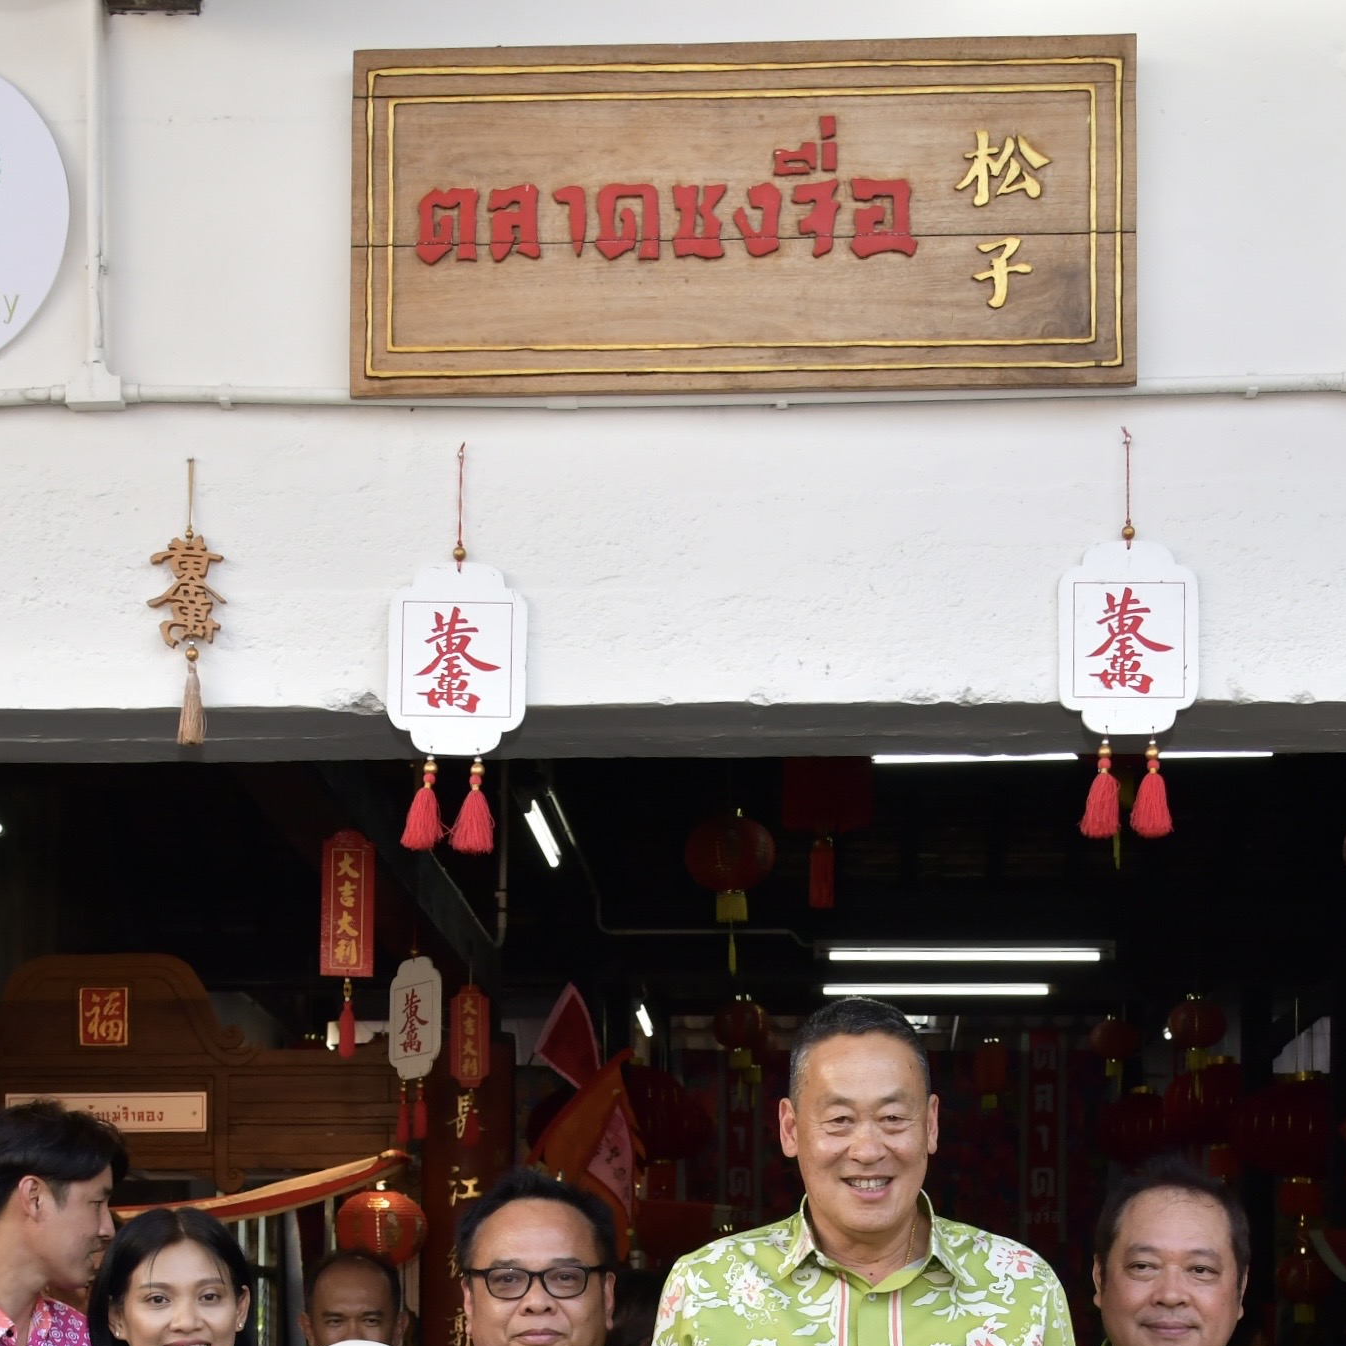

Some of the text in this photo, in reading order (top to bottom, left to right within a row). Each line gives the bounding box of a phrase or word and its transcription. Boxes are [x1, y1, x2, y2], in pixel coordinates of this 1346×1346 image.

[416, 114, 919, 267] ตลาดชงจื่อ
[954, 130, 1050, 309] 松子
[336, 851, 360, 967] 大吉大利
[85, 992, 125, 1044] 福
[462, 997, 478, 1077] 大吉大利
